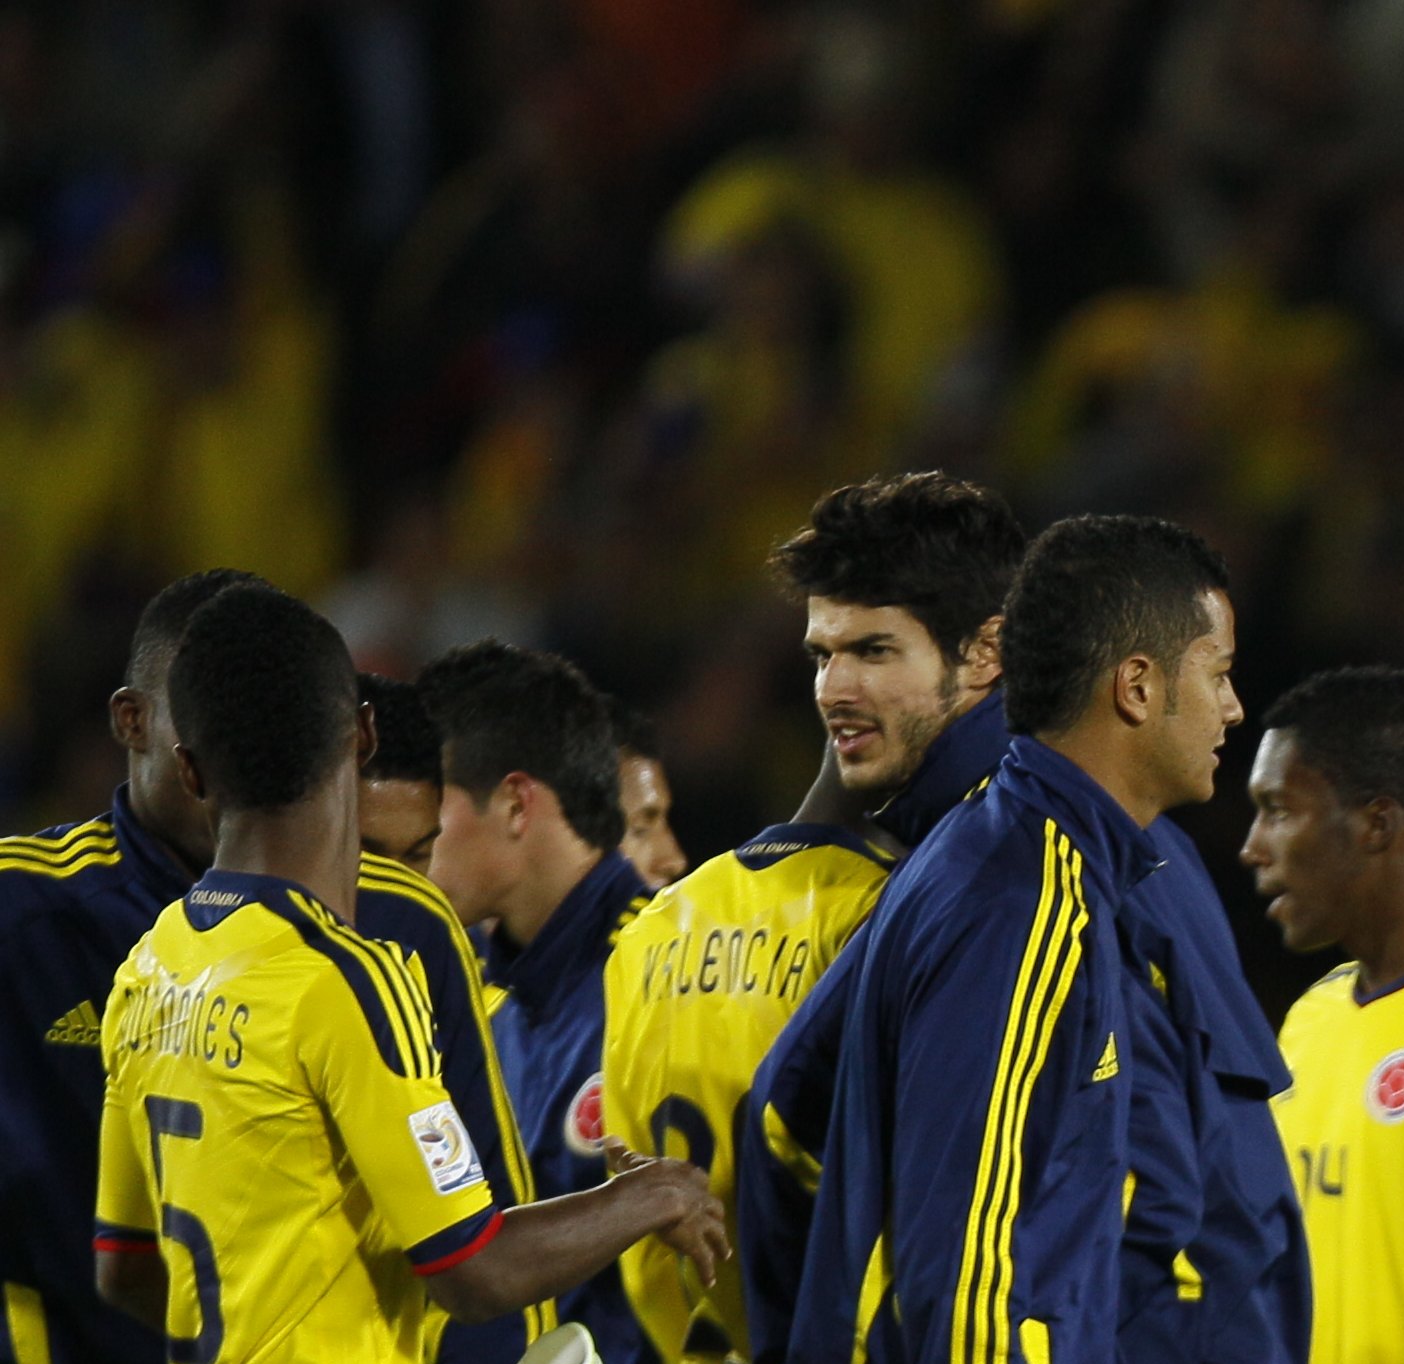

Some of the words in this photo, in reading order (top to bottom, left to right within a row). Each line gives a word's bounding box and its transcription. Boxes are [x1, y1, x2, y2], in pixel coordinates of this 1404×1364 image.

[190, 890, 245, 907] COLOMBIA
[643, 928, 810, 1003] VALENCIA
[44, 1027, 101, 1045] adida
